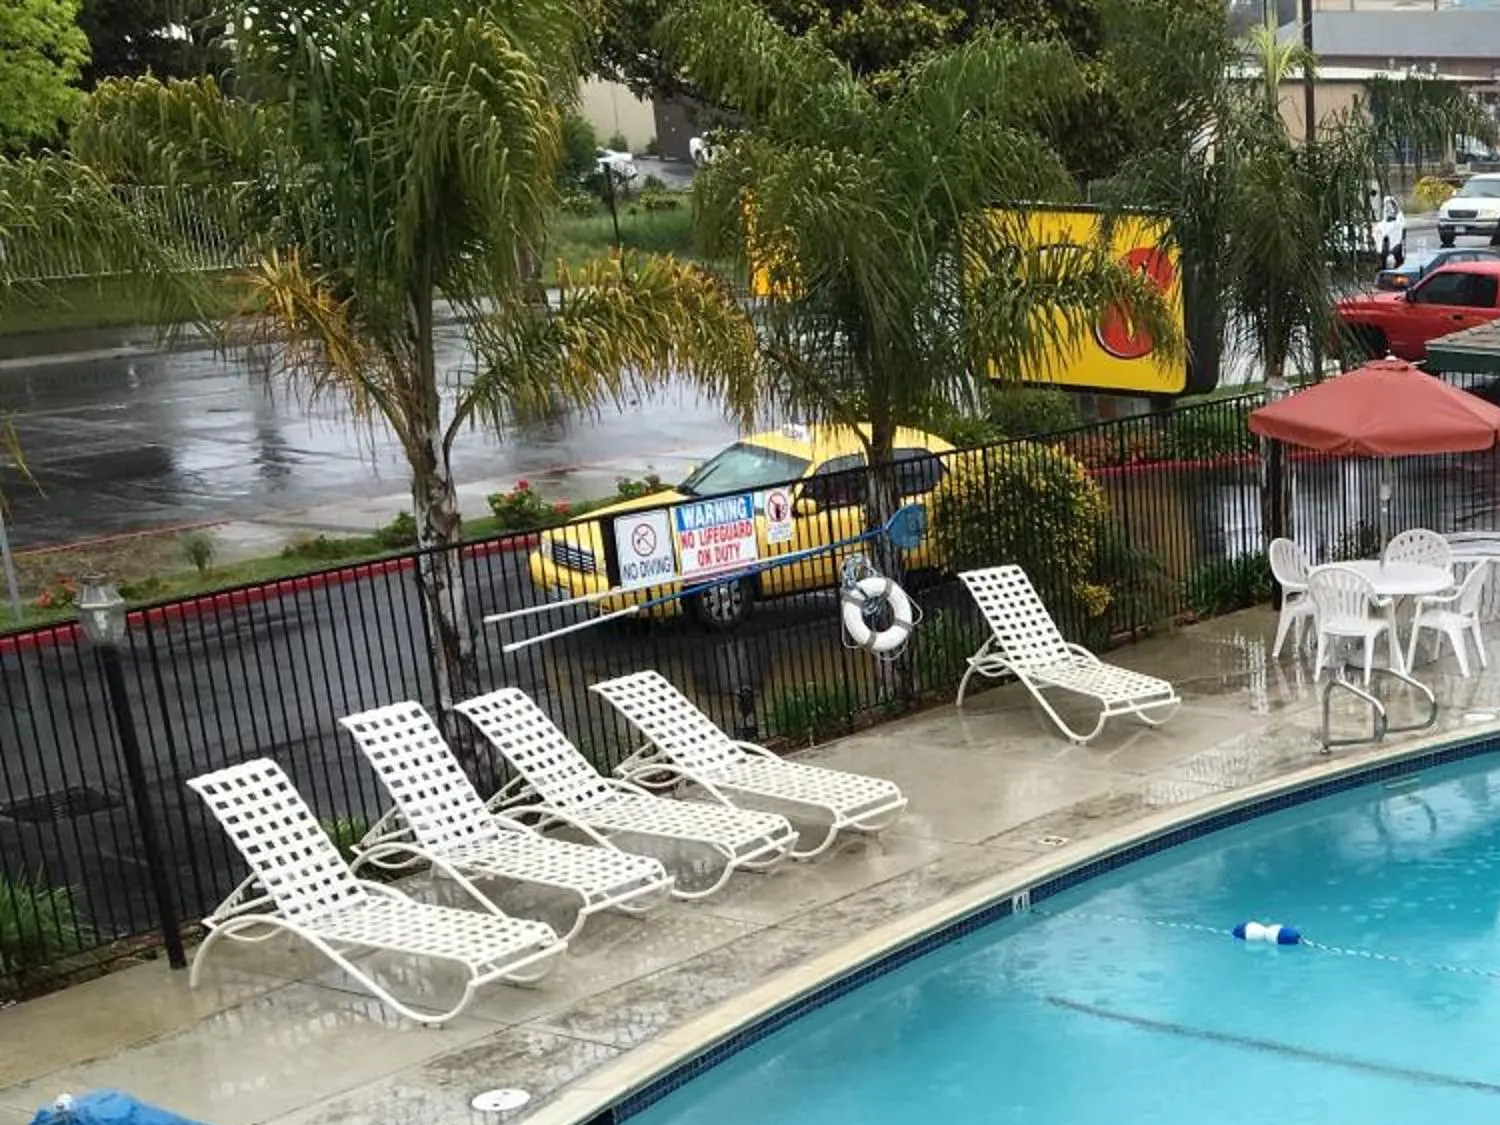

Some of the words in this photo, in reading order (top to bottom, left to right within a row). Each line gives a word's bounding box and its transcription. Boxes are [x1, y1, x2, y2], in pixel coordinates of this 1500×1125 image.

[681, 497, 747, 528] WARNING
[680, 530, 695, 549] NO
[699, 520, 753, 545] LIFEGUARD
[623, 562, 639, 581] NO
[639, 556, 671, 579] DIVING
[697, 549, 711, 567] ON
[714, 543, 741, 564] DUTY
